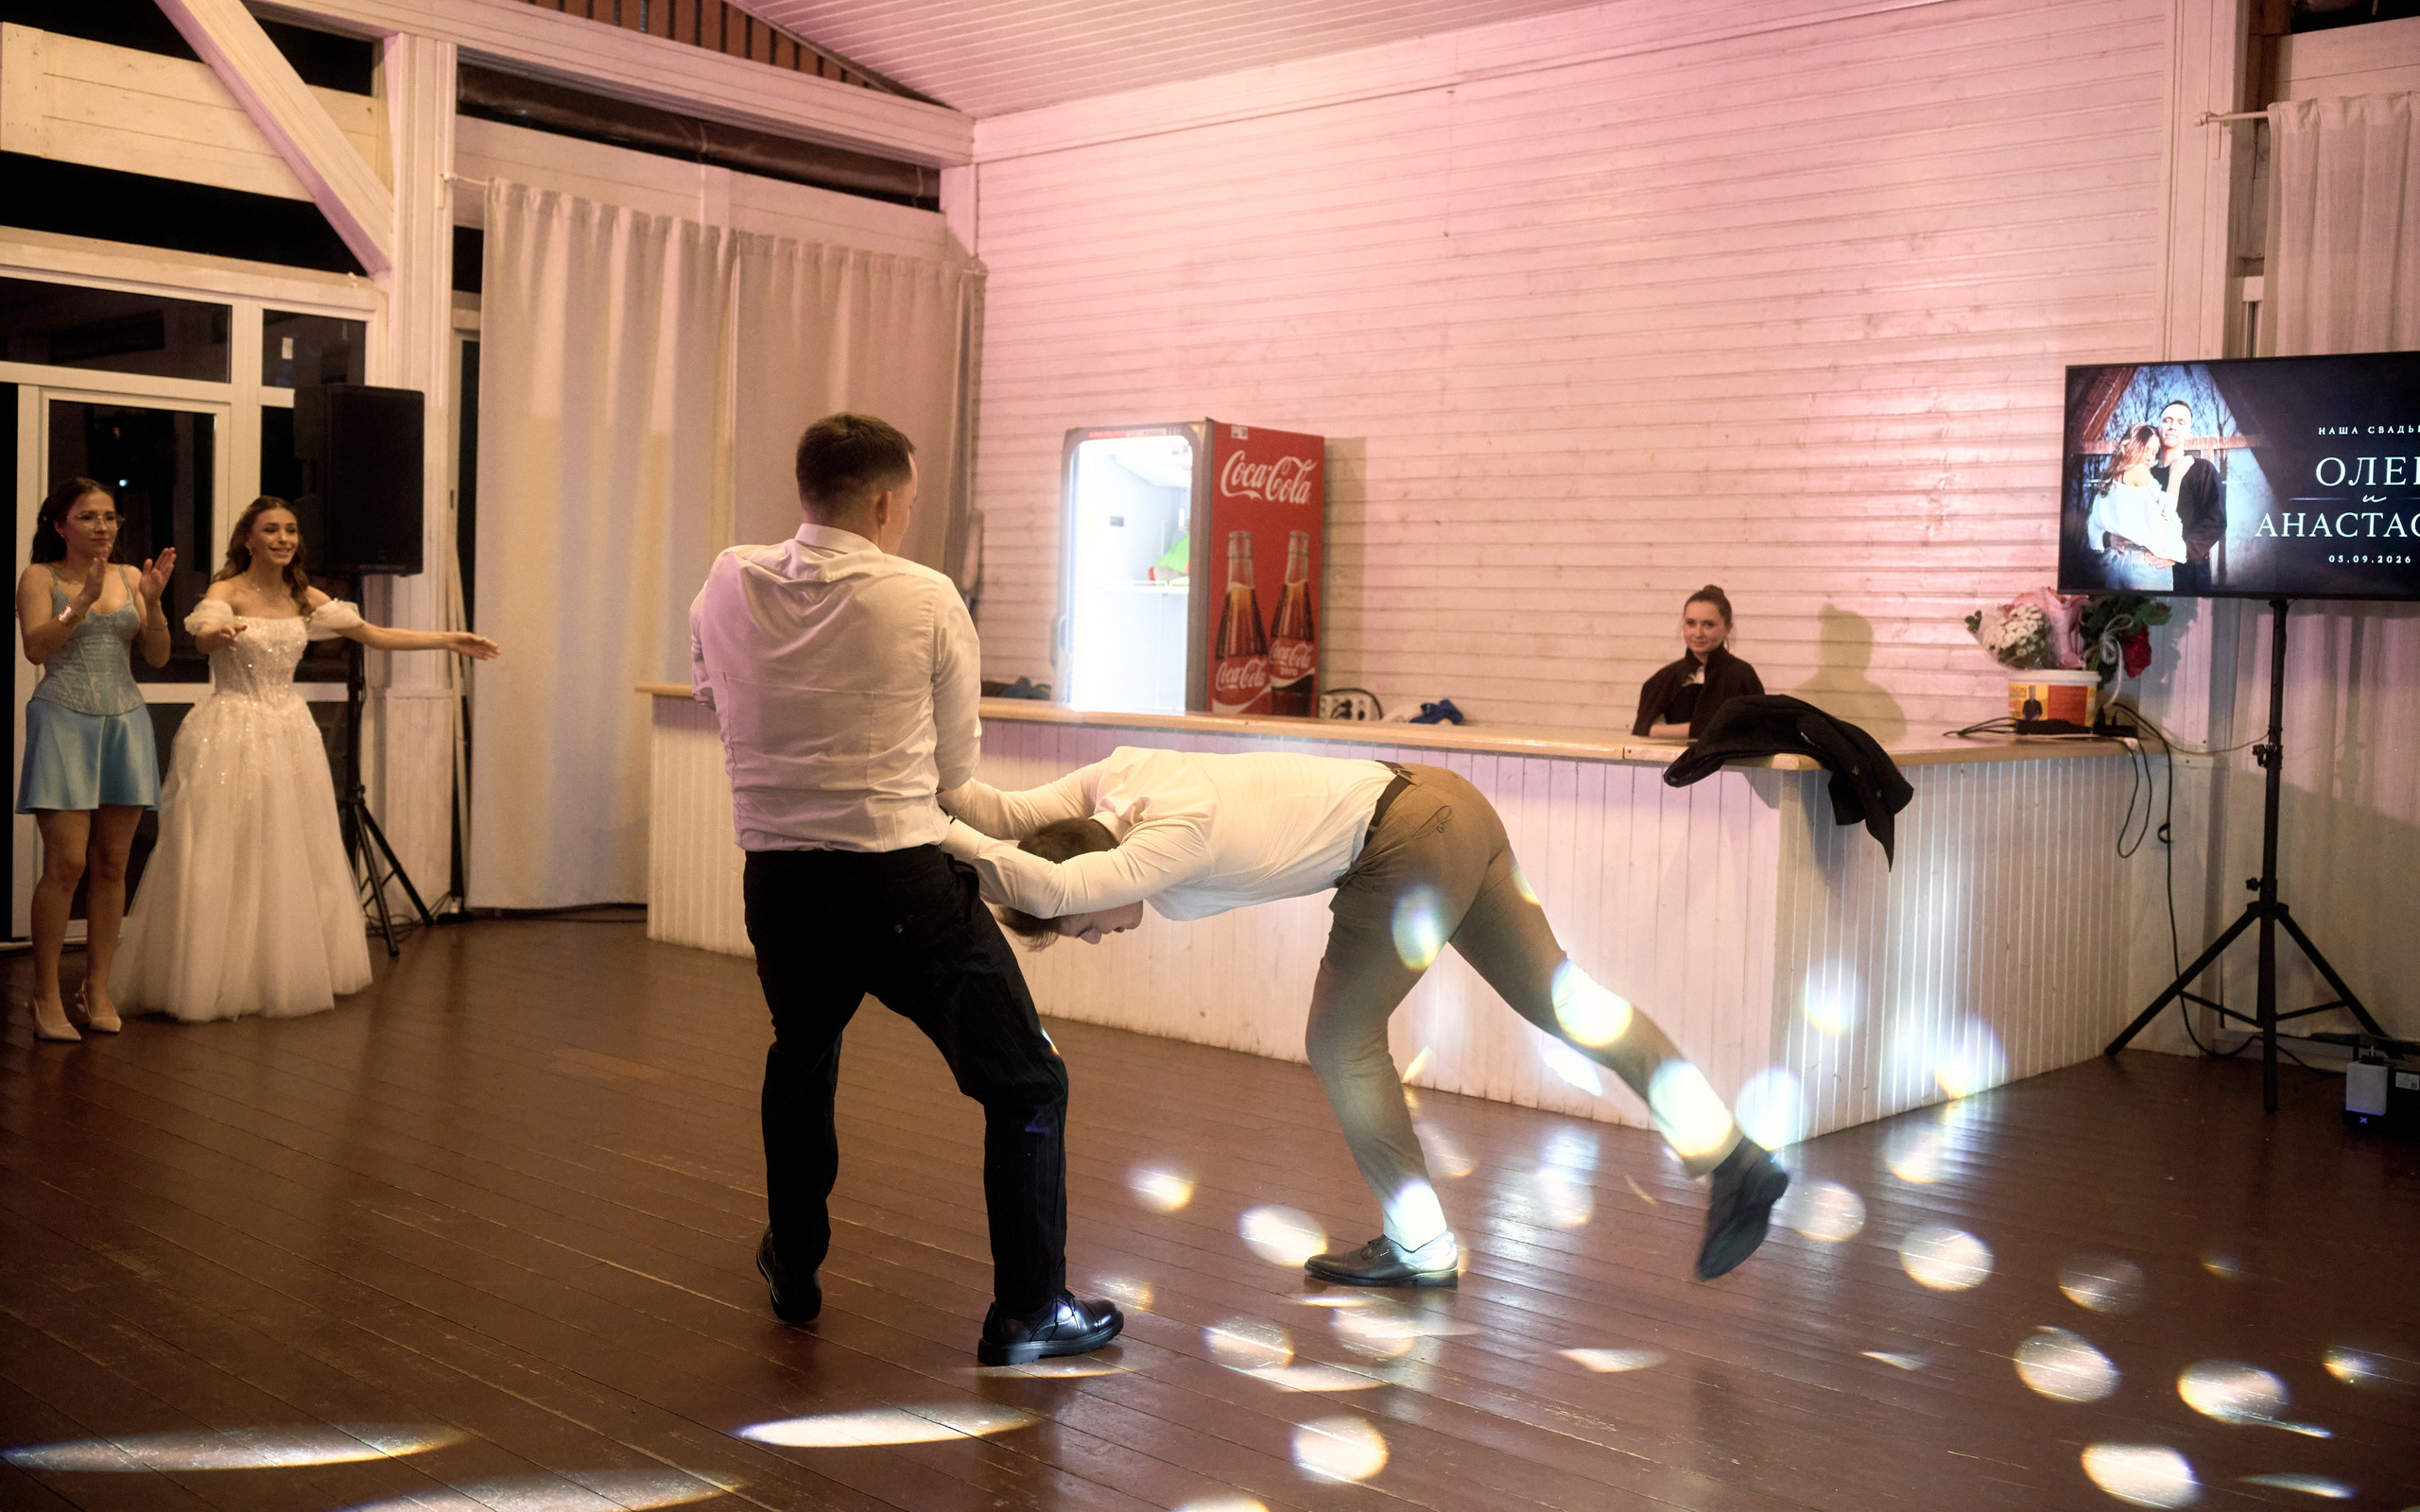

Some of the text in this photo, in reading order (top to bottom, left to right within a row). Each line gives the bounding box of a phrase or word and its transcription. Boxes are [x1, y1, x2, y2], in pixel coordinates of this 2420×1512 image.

[2318, 426, 2359, 436] НАША
[1220, 450, 1318, 505] Coca-Cola
[1216, 659, 1267, 692] Coca-Cola
